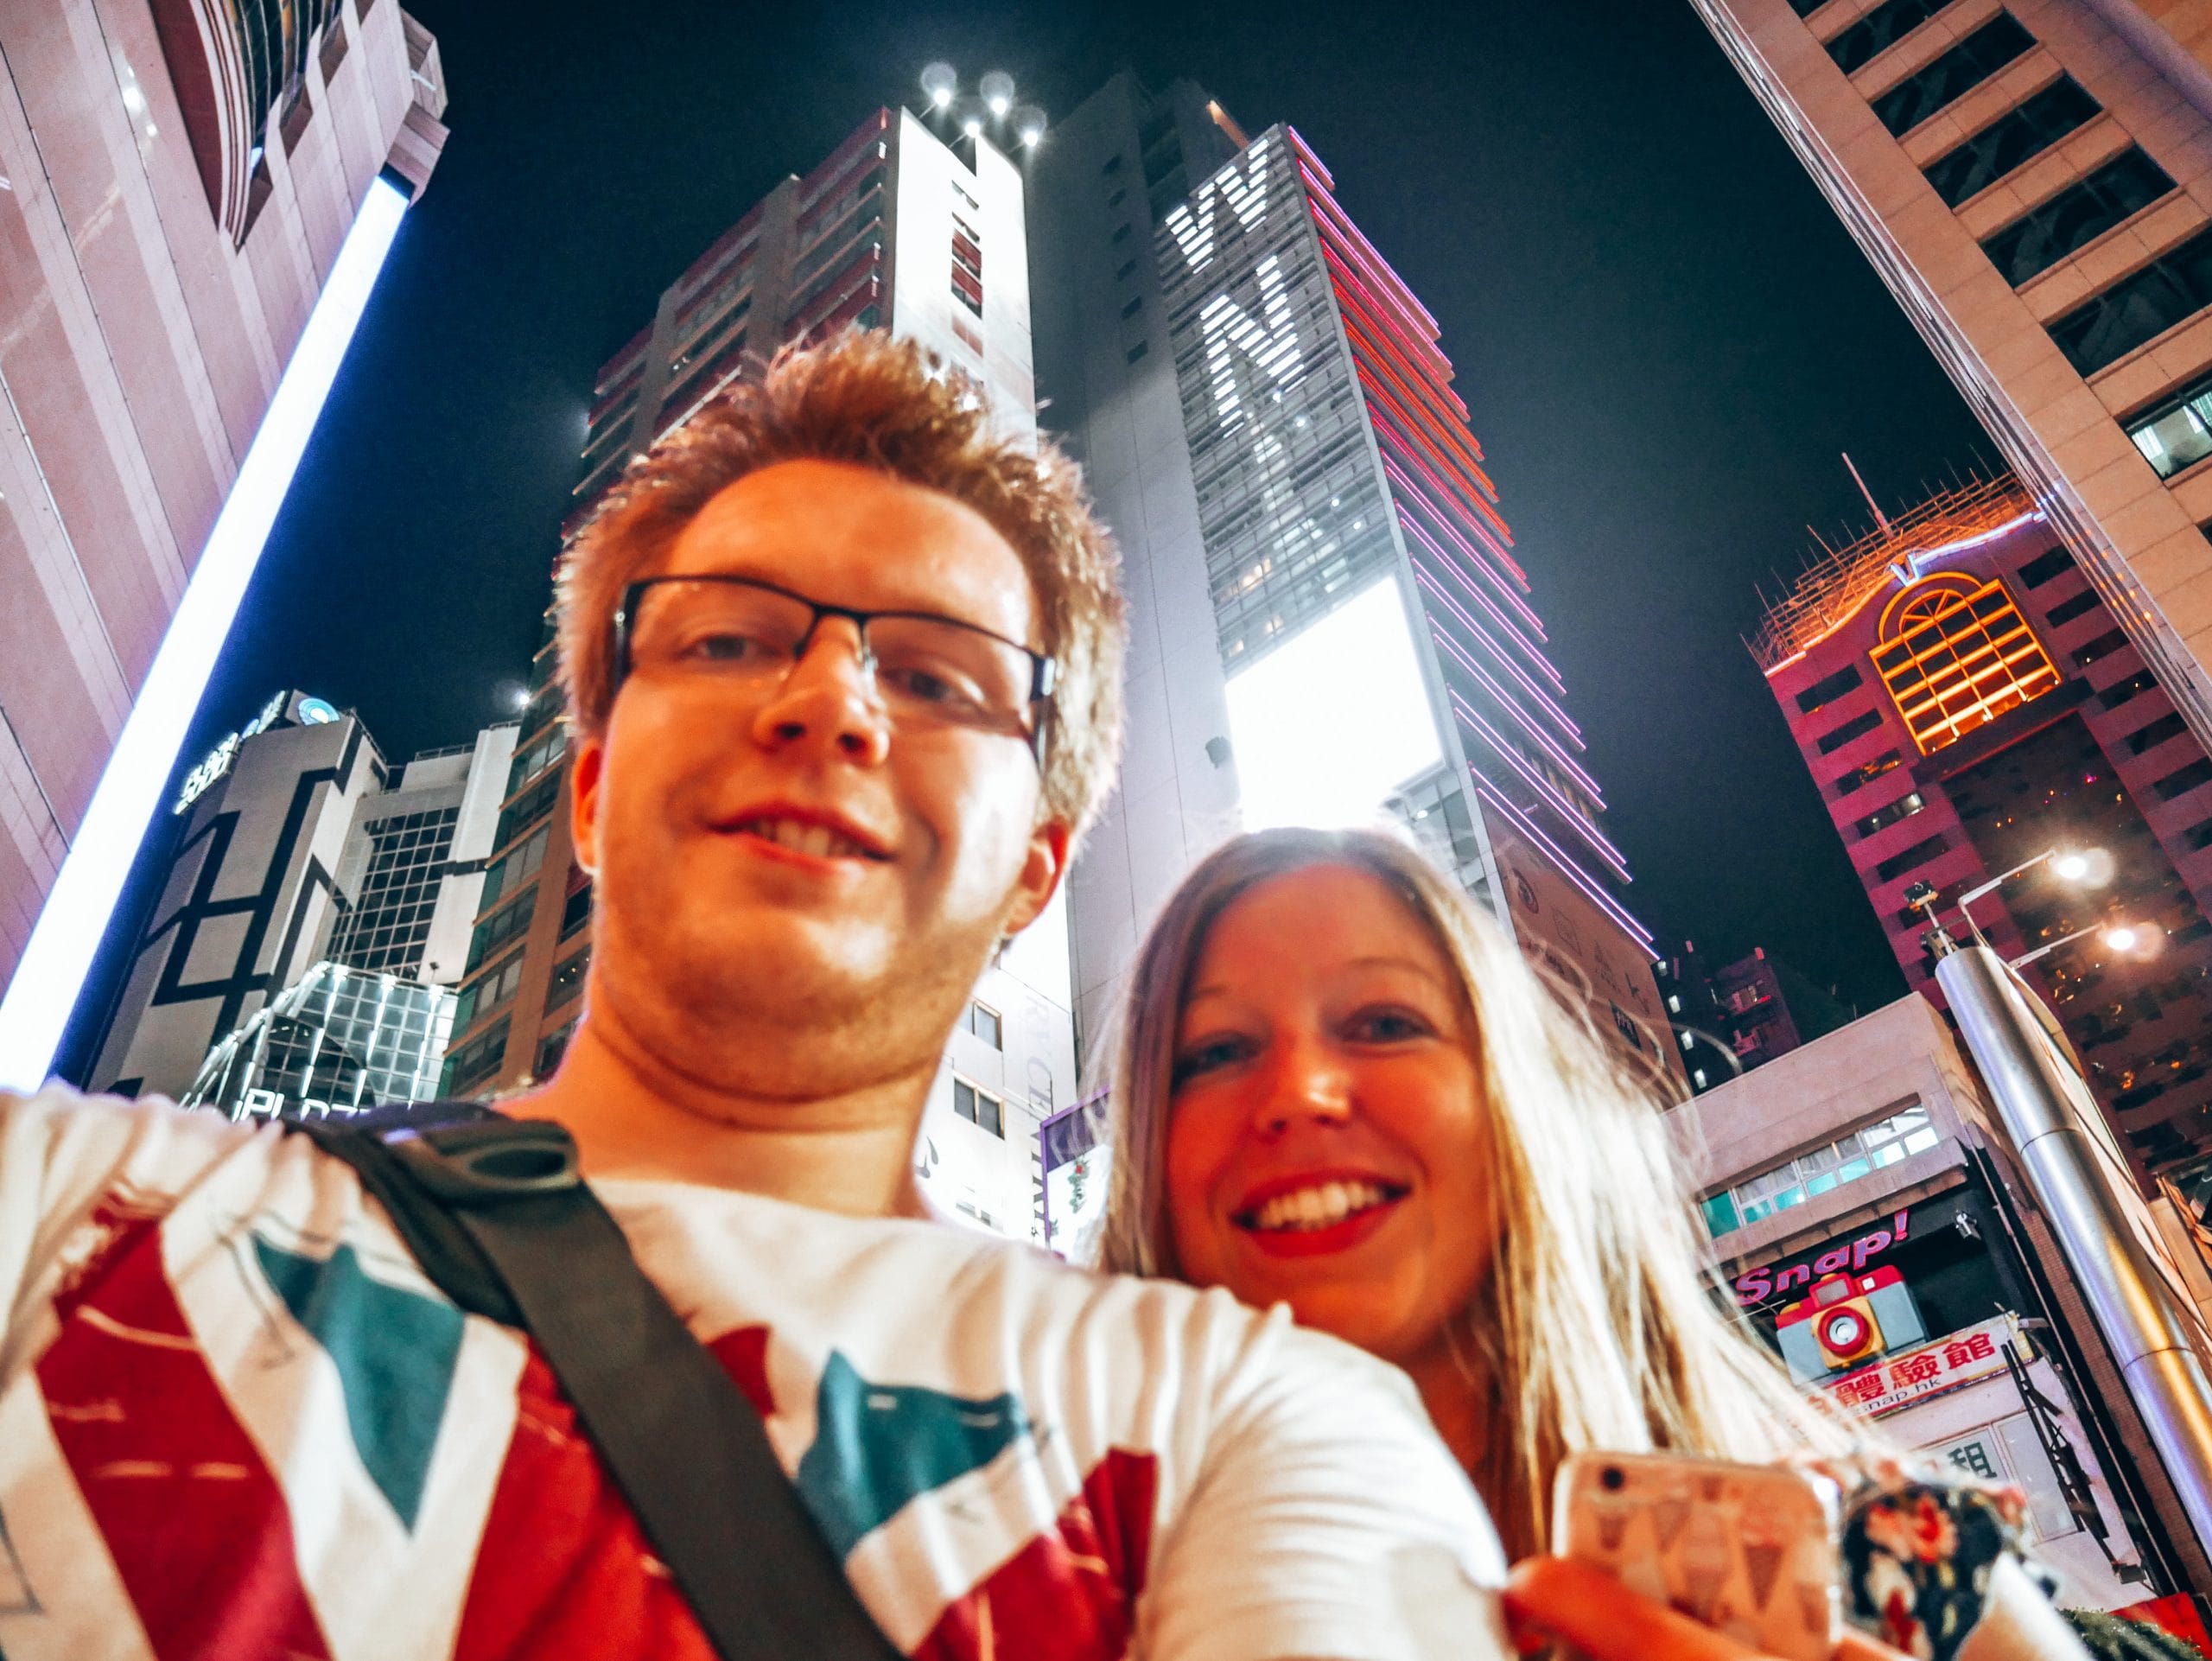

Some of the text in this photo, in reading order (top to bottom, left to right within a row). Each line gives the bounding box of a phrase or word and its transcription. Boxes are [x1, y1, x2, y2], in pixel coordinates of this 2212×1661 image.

[1735, 1208, 1909, 1307] Snap!
[1808, 1332, 1996, 1415] 體驗館
